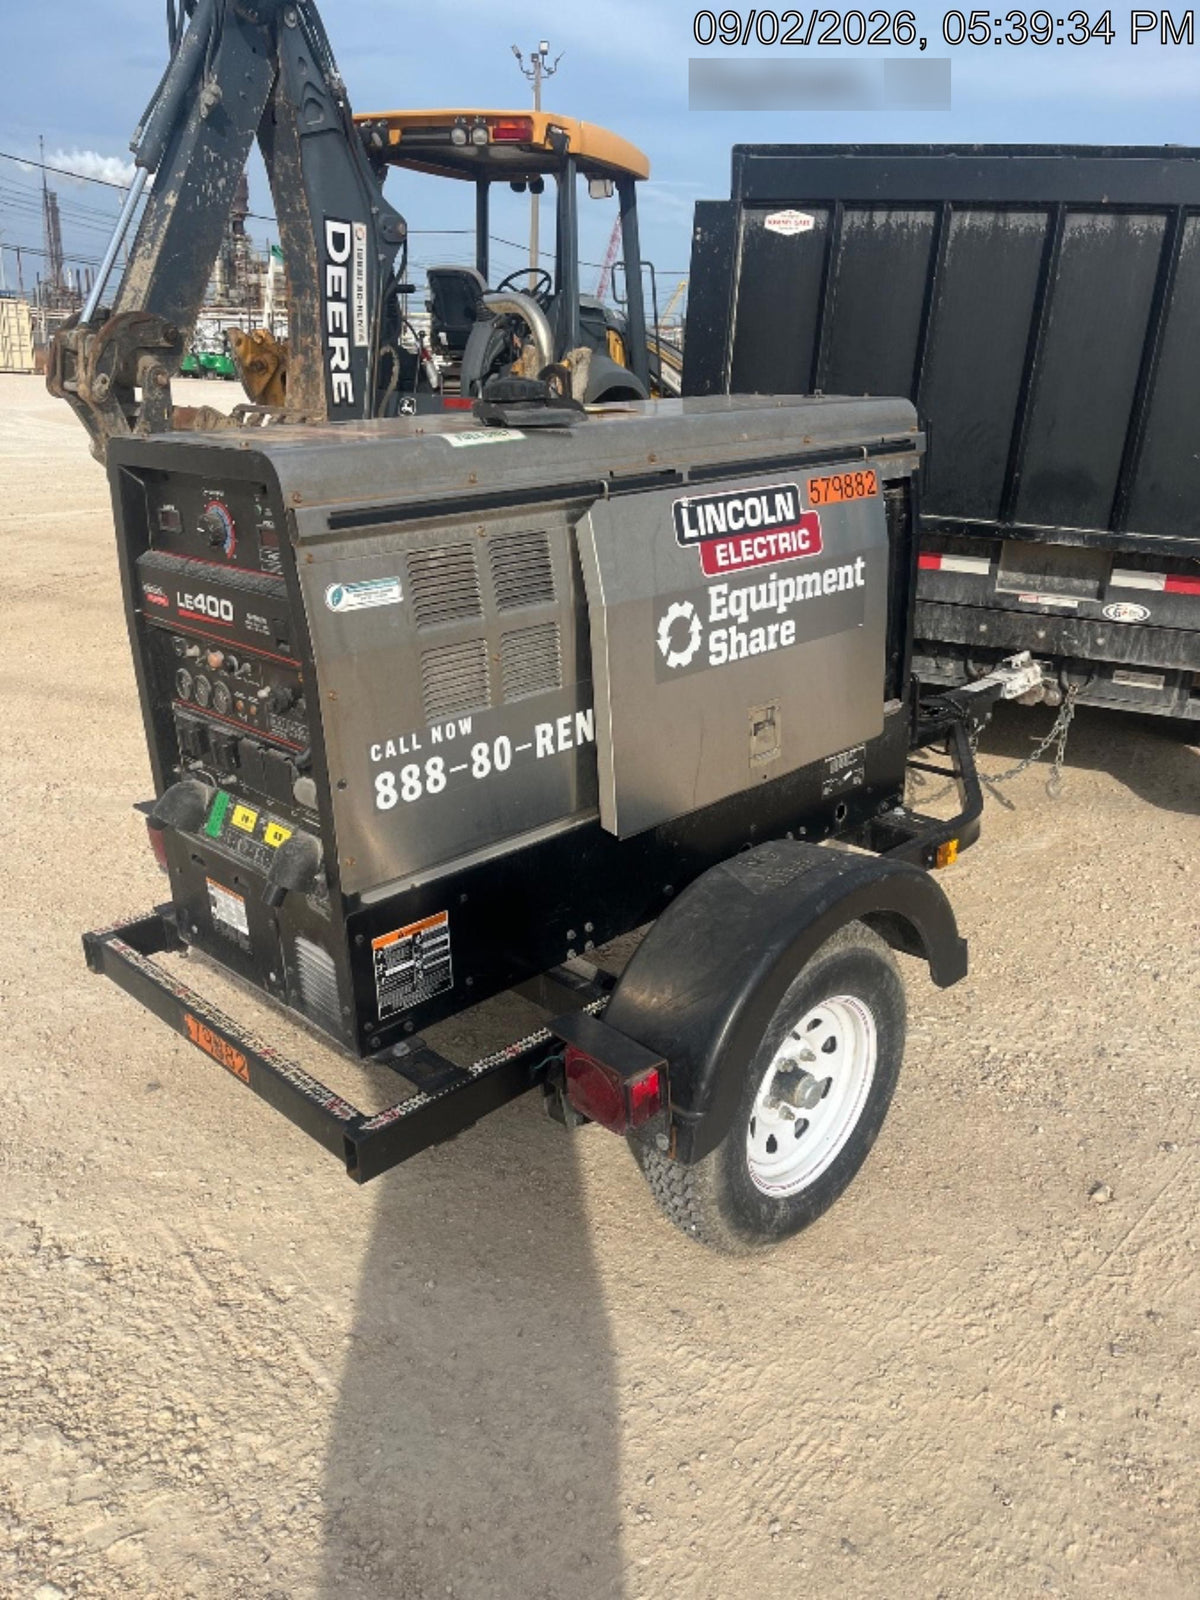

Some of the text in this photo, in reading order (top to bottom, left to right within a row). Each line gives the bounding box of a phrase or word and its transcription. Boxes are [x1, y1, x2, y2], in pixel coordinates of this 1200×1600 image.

[325, 219, 354, 404] DEERE
[809, 470, 877, 505] 579882
[681, 491, 795, 539] LINCOLN
[714, 528, 811, 567] ELECTRIC
[176, 591, 234, 622] LE400
[708, 556, 866, 624] Equipment
[708, 619, 796, 666] Share
[370, 717, 472, 762] CALL NOW
